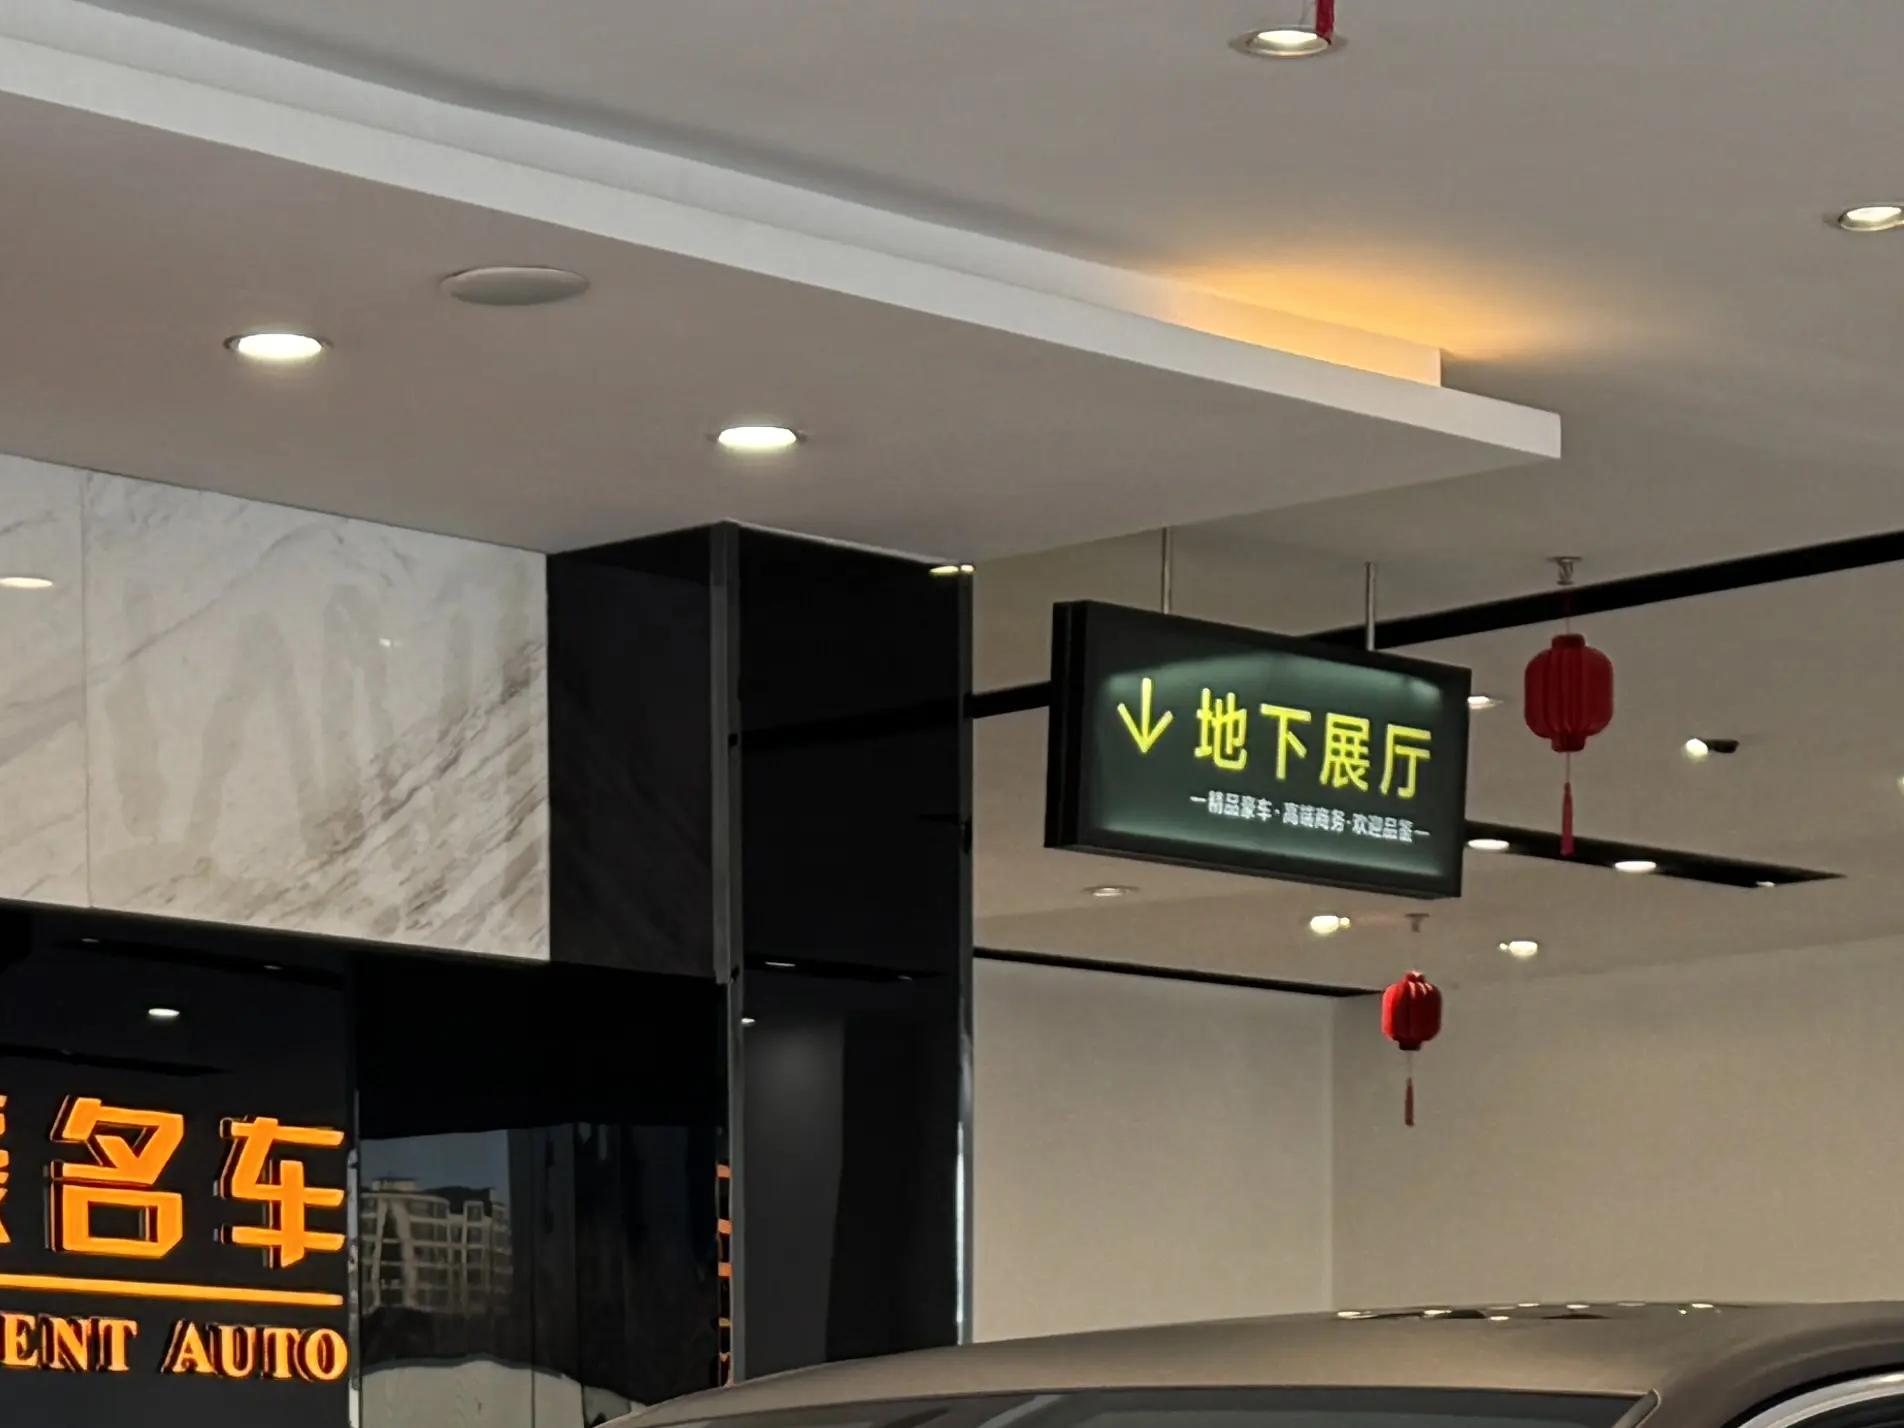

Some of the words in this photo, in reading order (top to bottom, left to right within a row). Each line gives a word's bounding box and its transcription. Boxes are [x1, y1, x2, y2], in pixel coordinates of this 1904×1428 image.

[1194, 687, 1432, 799] 地下展厅
[165, 1322, 349, 1381] AUTO
